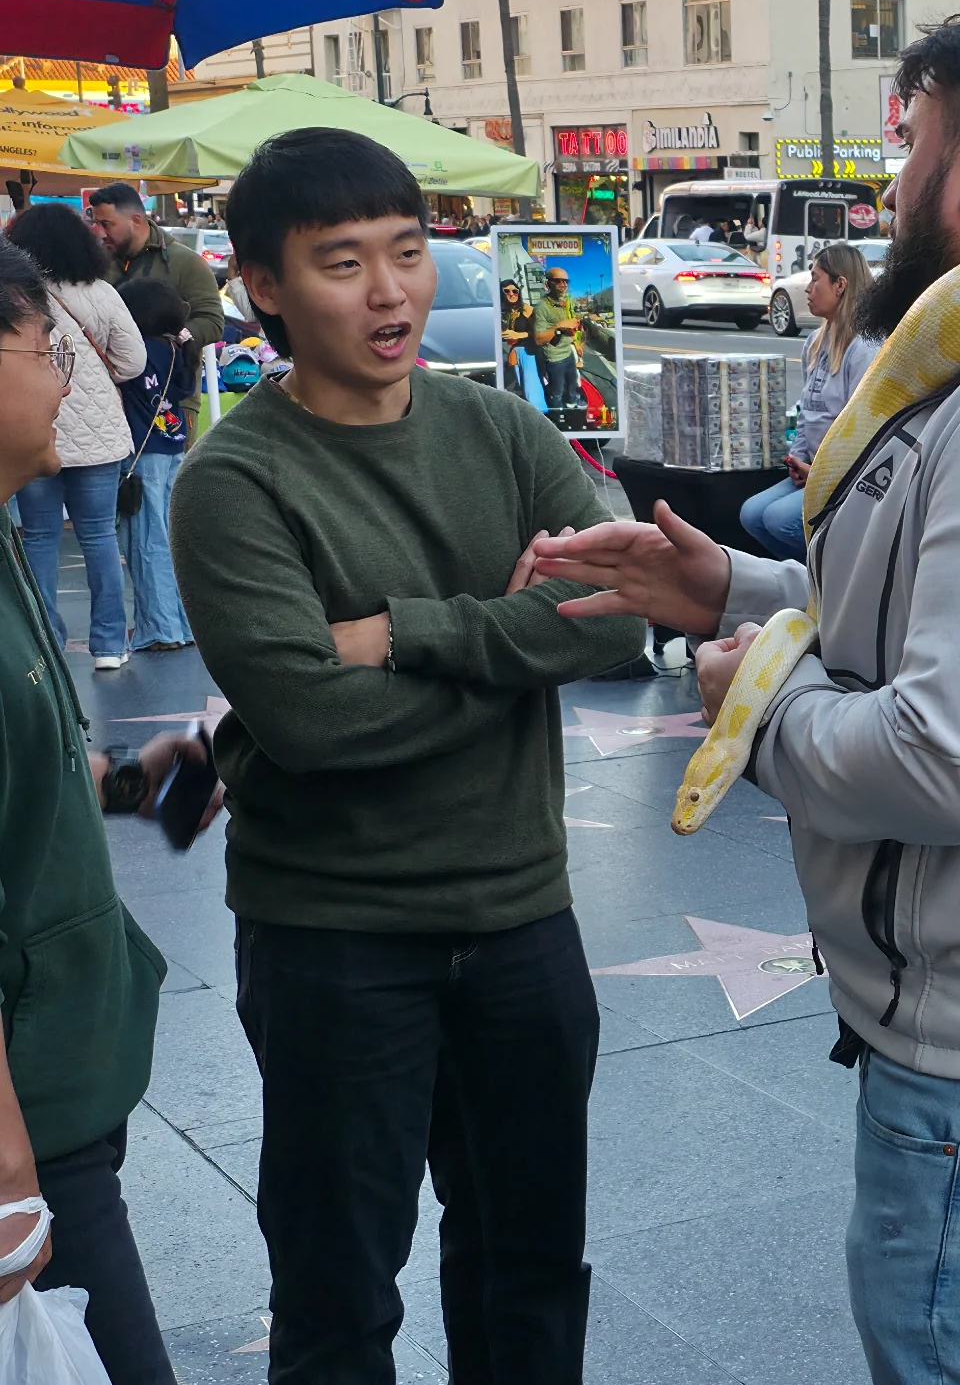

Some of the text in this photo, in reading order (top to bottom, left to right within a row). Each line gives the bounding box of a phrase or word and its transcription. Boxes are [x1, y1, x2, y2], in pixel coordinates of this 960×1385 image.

[0, 106, 80, 117] llywood
[559, 131, 628, 155] TATTOO
[788, 144, 881, 162] Publi Parking
[531, 240, 579, 250] HOLLYWOOD
[144, 374, 159, 389] M
